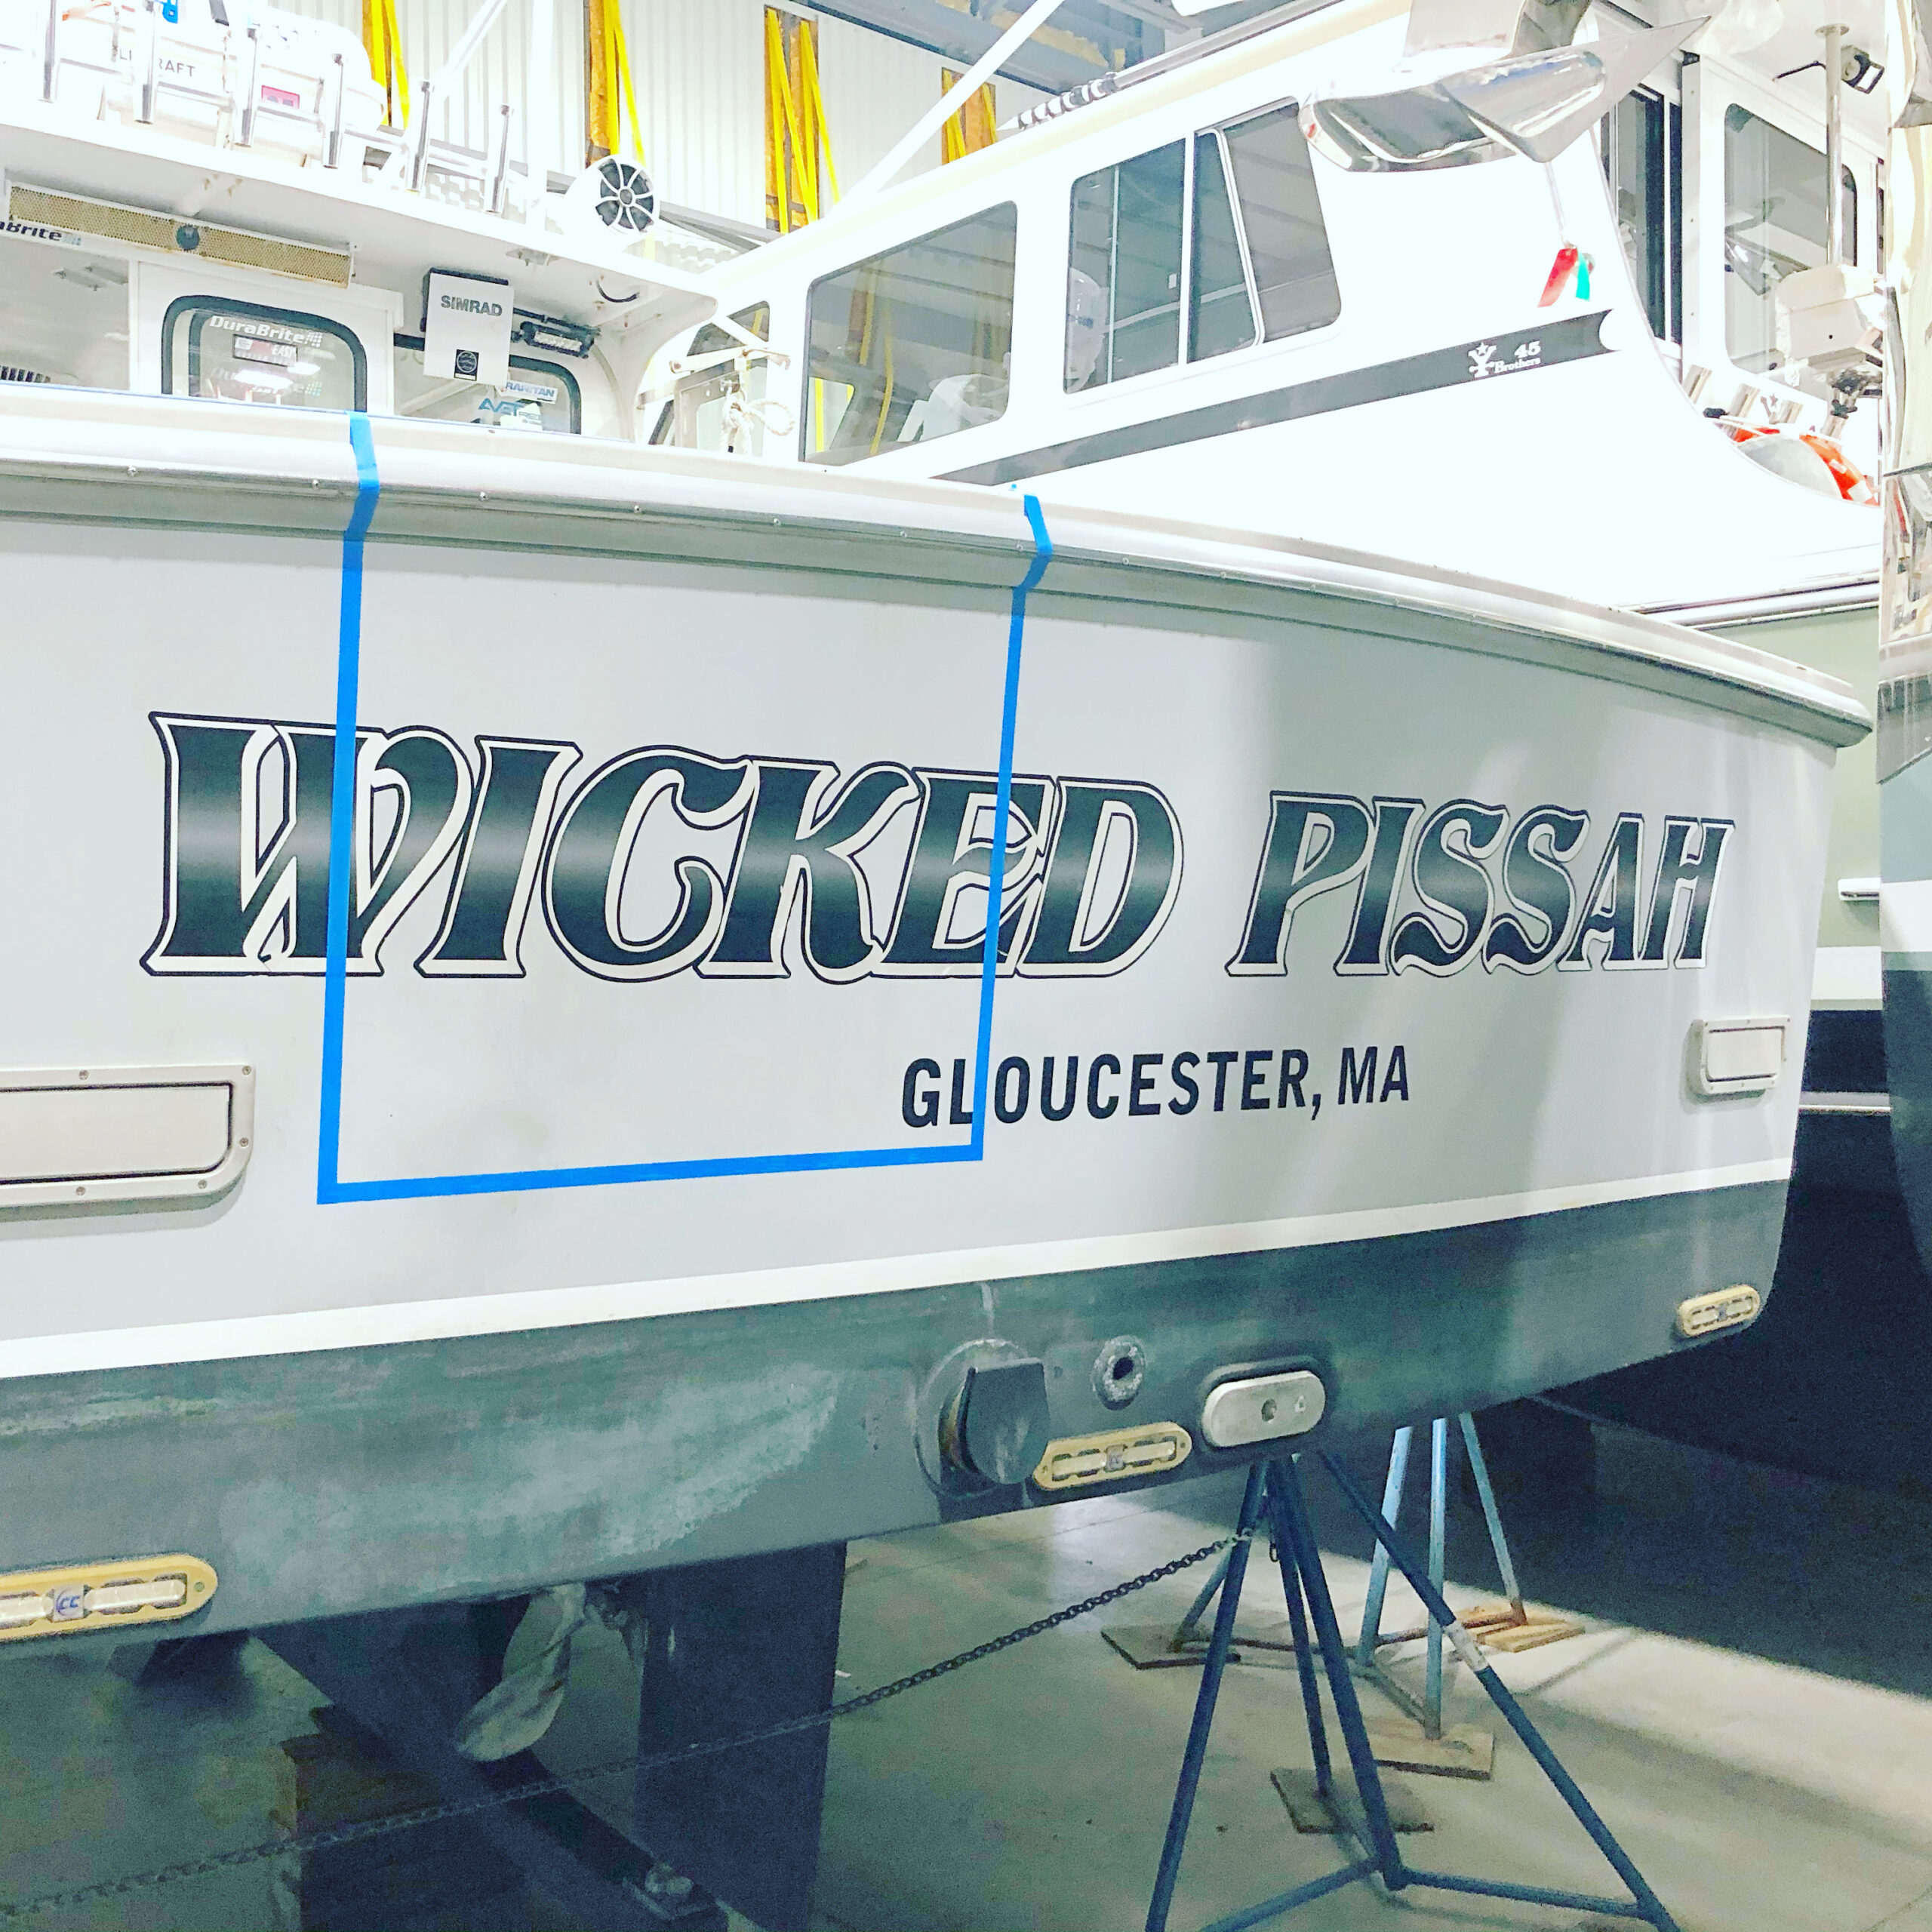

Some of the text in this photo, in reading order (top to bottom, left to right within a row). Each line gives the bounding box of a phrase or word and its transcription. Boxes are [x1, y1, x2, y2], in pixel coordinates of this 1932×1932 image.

[441, 294, 503, 316] SIMRAD
[210, 315, 305, 344] DuraBrite
[1514, 340, 1541, 358] 45
[140, 711, 1735, 985] WICKED PISSAH
[903, 1045, 1409, 1128] GLOUCESTER, MA
